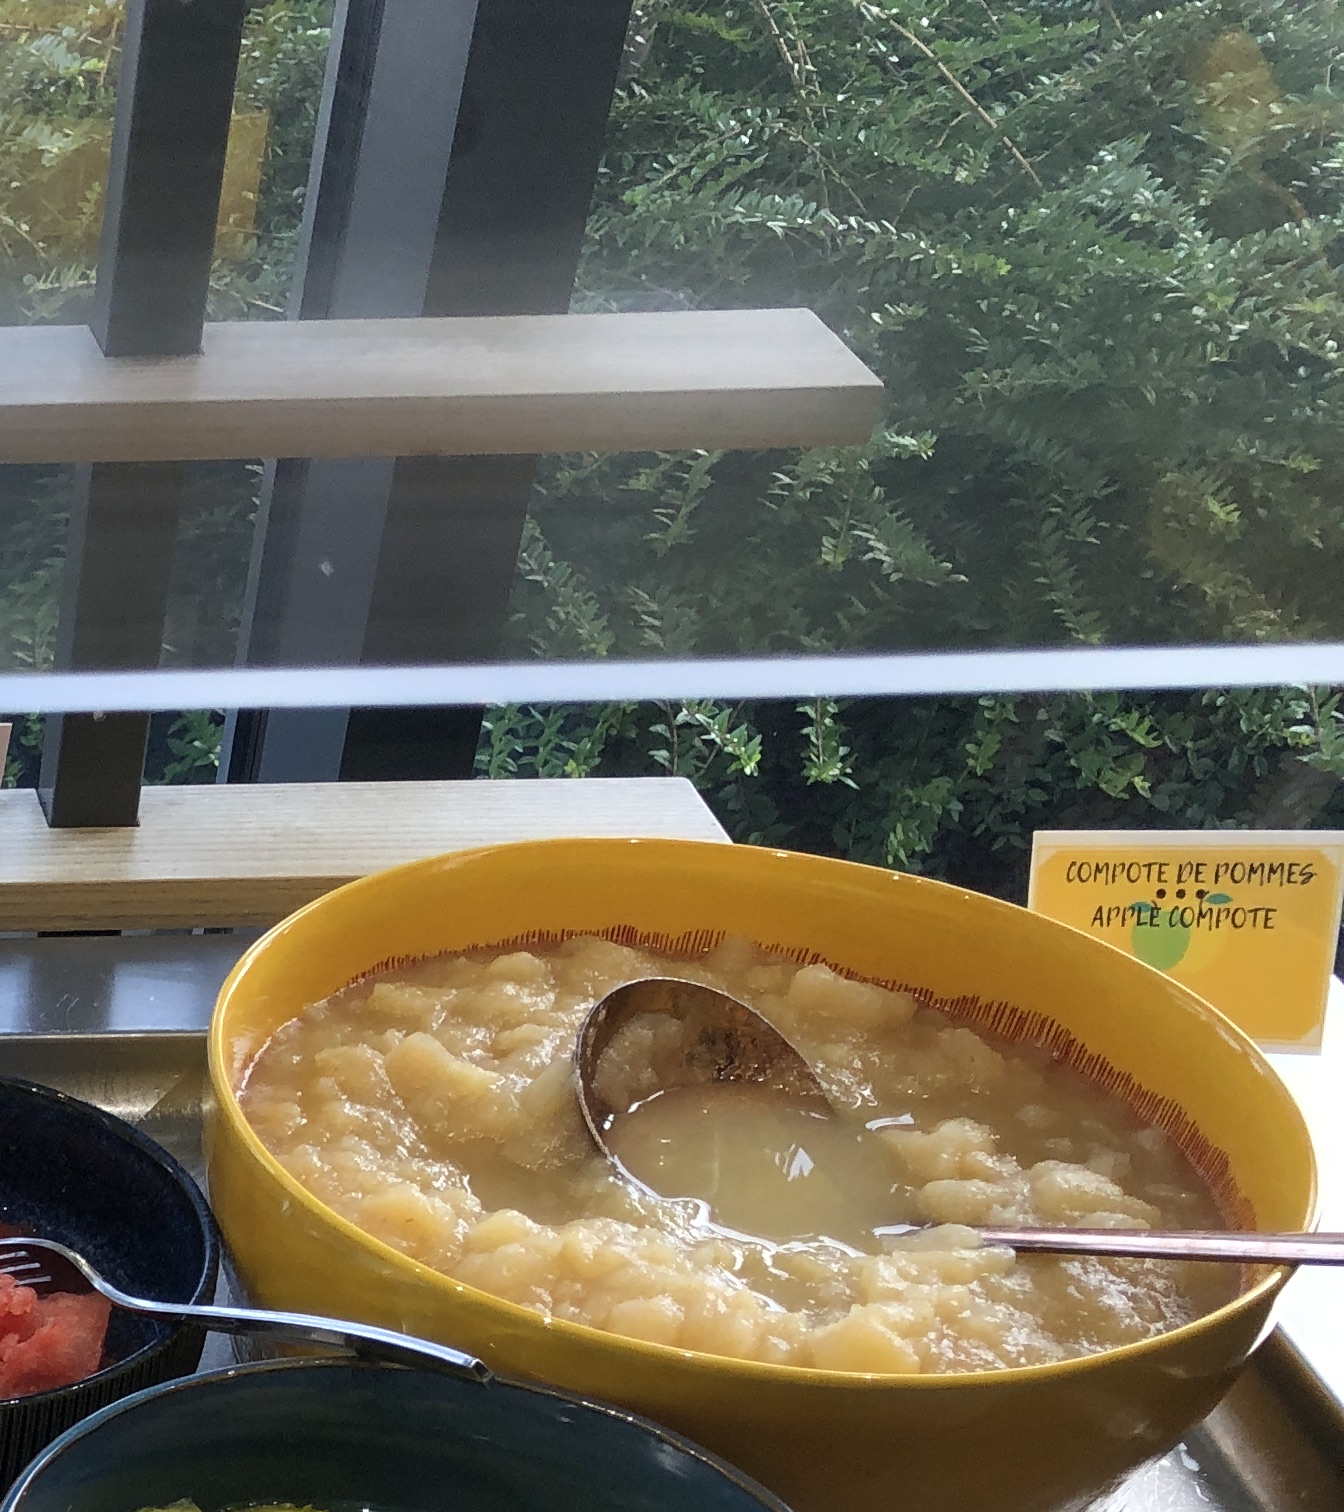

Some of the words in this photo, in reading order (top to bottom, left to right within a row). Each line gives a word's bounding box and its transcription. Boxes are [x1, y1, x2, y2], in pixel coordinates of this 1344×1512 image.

[1066, 860, 1170, 886] COMPOTE
[1176, 860, 1207, 884] DE
[1214, 860, 1318, 887] POMMES
[1091, 904, 1161, 928] APPLE
[1168, 904, 1277, 931] COMPOTE
